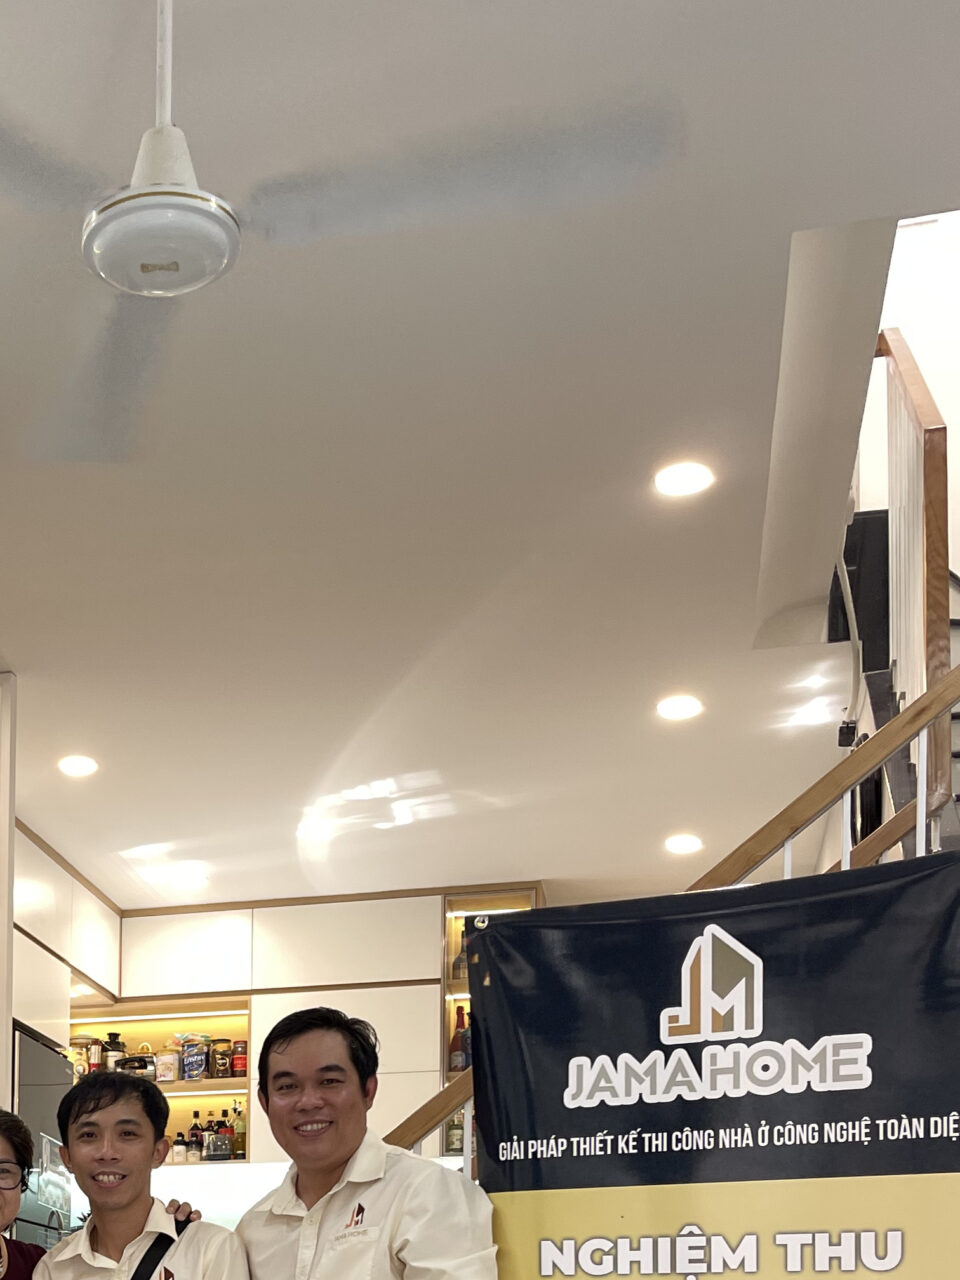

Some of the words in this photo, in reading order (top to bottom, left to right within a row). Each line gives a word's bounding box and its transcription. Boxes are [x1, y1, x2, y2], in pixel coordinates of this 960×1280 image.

[499, 1136, 524, 1160] GIẢI
[528, 1135, 567, 1158] PHÁP
[570, 1130, 614, 1156] THIẾT
[618, 1128, 641, 1154] KẾ
[642, 1133, 667, 1152] THI
[672, 1127, 714, 1151] CÔNG
[719, 1124, 753, 1148] NHÀ
[758, 1121, 769, 1146] Ở
[774, 1121, 818, 1145] CÔNG
[824, 1117, 871, 1145] NGHỆ
[876, 1115, 924, 1140] TOÀN
[776, 1230, 904, 1273] THU
